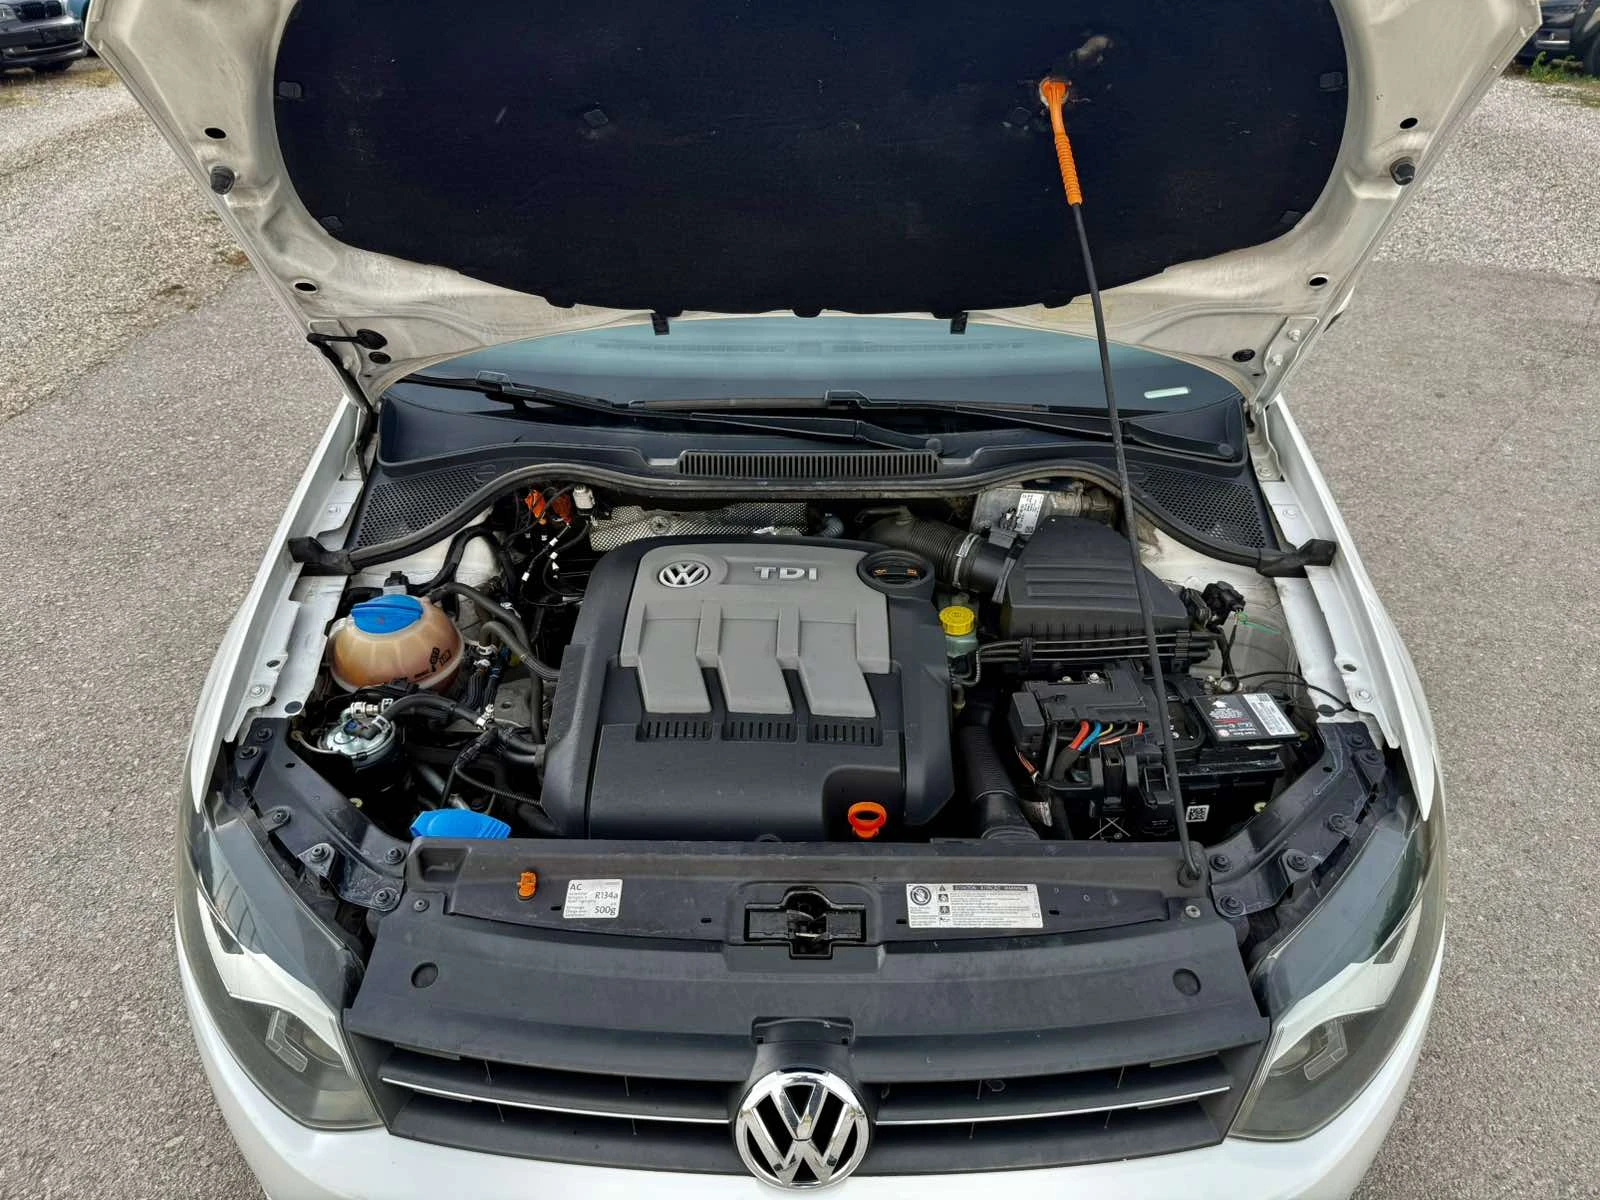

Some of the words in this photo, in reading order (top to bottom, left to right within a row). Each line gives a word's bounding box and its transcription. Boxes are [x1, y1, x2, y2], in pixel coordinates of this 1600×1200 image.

[754, 566, 817, 580] TDI
[595, 891, 618, 899] R134a
[594, 905, 616, 915] 500g
[736, 1070, 869, 1190] VW
